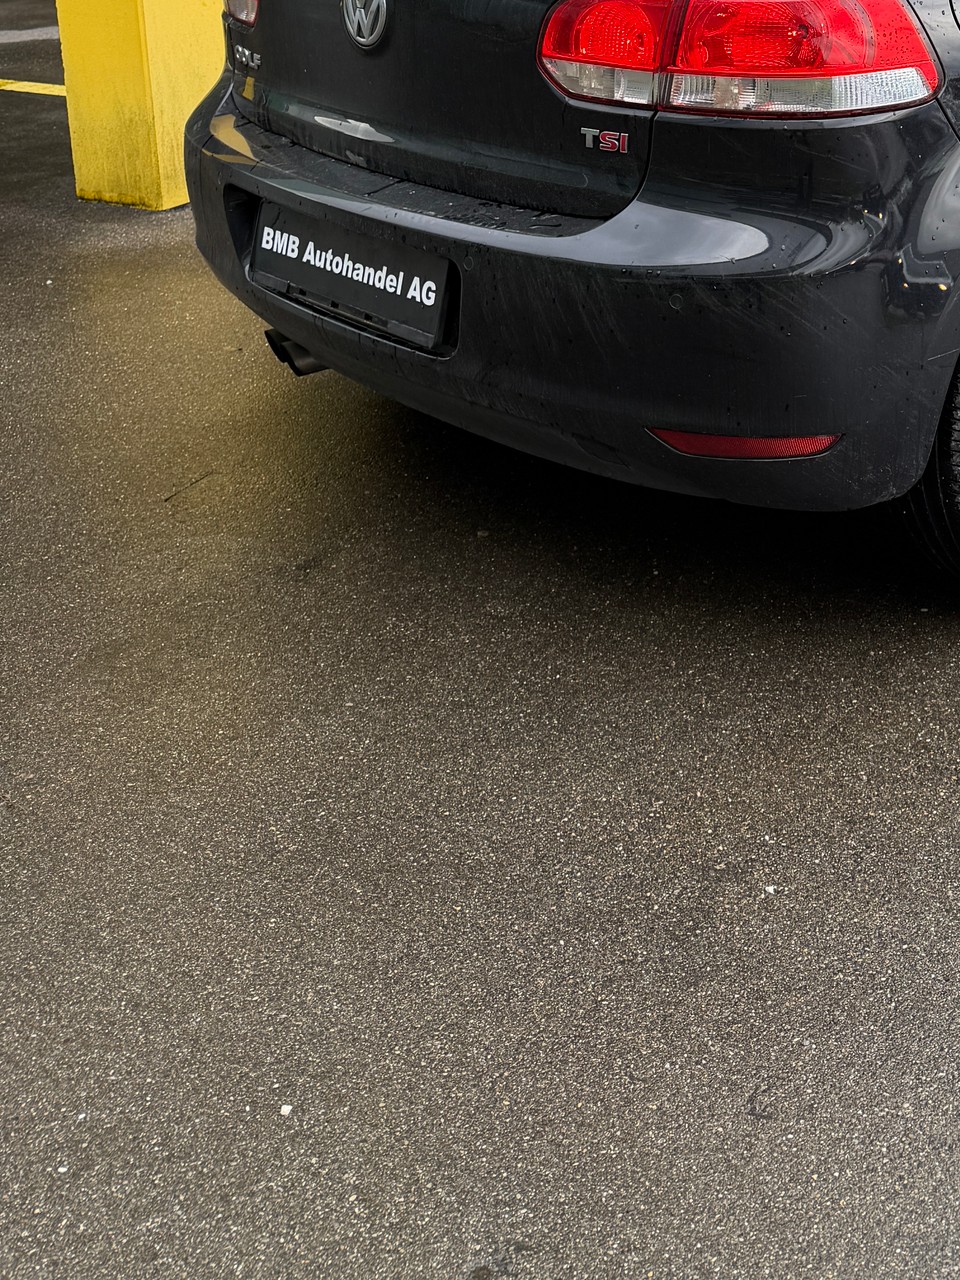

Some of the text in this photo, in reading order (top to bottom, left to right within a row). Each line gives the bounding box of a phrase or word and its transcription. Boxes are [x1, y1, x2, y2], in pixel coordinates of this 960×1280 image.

[580, 127, 629, 153] TSI
[261, 226, 437, 306] BMB Autohandel AG
